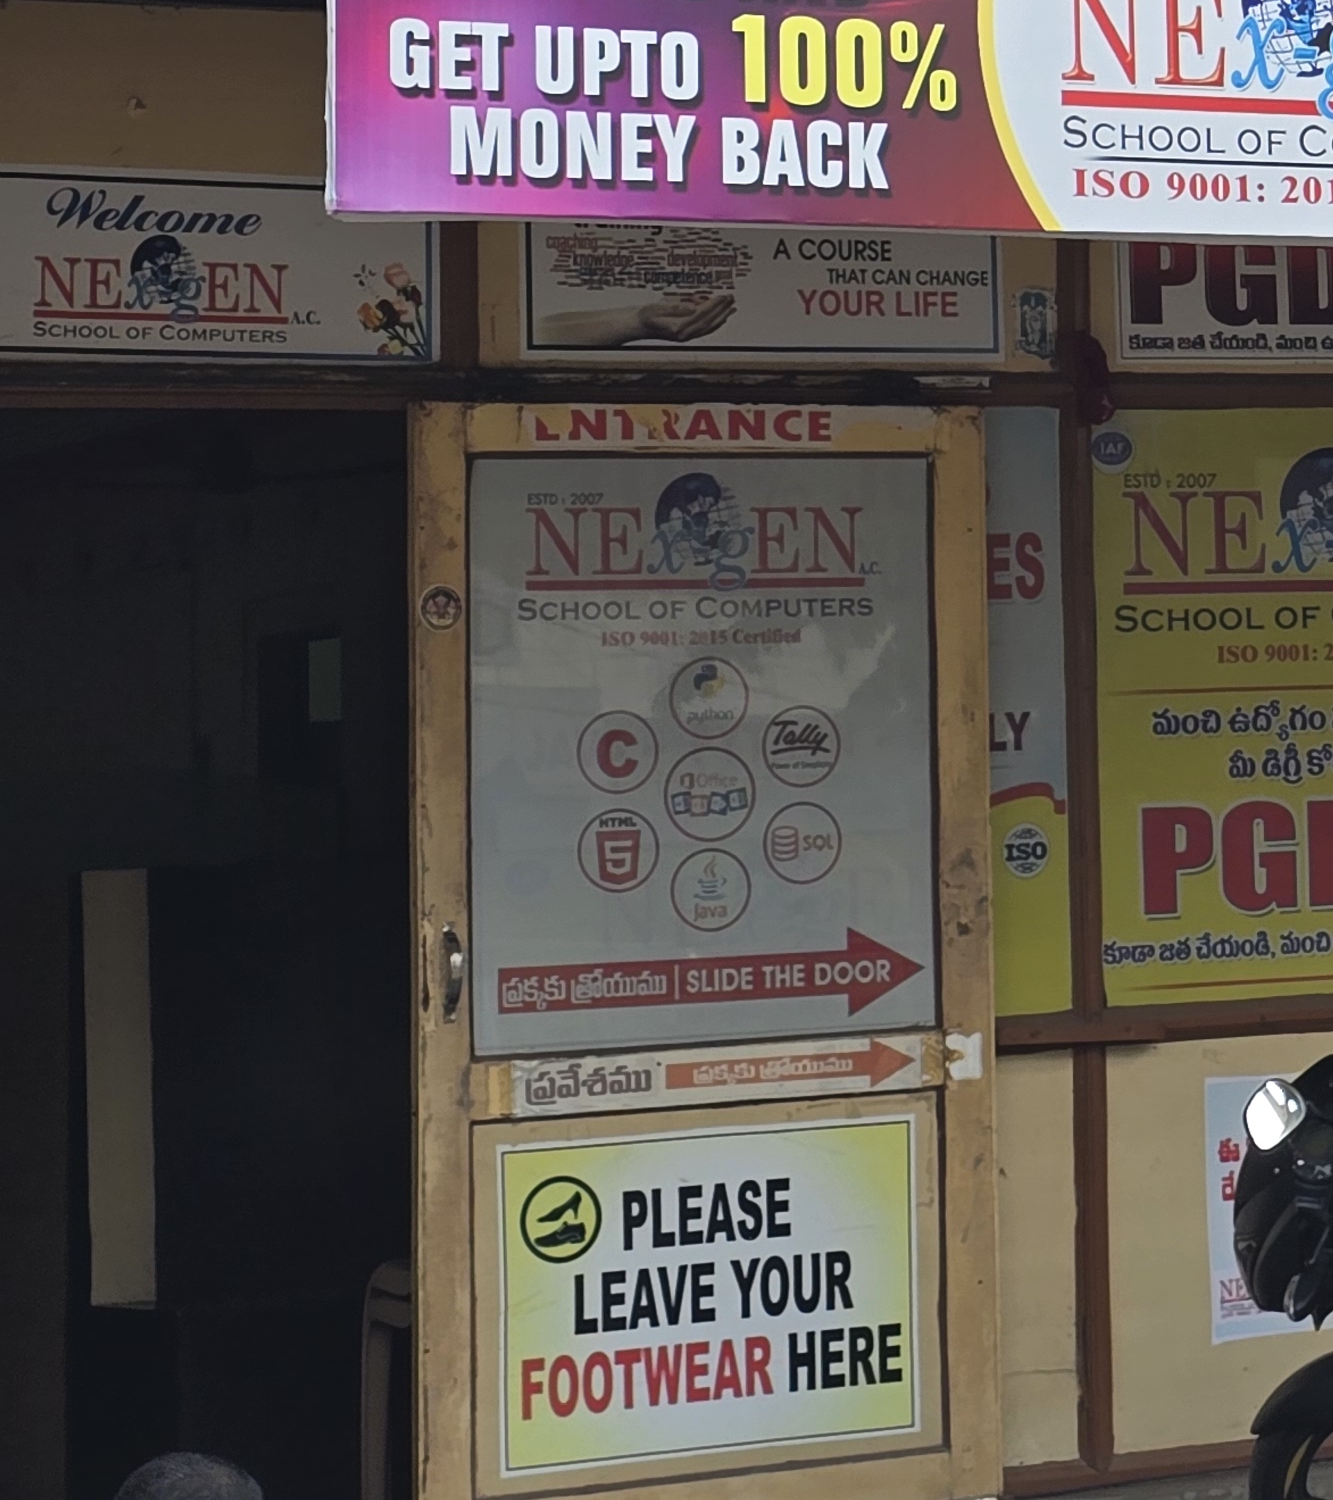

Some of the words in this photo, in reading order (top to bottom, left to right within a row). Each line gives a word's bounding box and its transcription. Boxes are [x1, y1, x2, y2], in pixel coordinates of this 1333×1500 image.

[389, 18, 510, 92] GET
[535, 25, 700, 100] UPTO
[732, 14, 957, 112] 100%
[450, 106, 696, 184] MONEY
[722, 117, 889, 190] BACK
[46, 186, 262, 236] Welcome
[773, 239, 792, 260] A
[799, 240, 891, 262] COURSE
[799, 289, 884, 317] YOUR
[896, 291, 959, 318] LIFE
[827, 269, 867, 286] THAT
[872, 269, 911, 286] CAN
[916, 269, 989, 288] CHANGE
[1152, 708, 1221, 737] మంచి
[1227, 700, 1326, 742] ఉద్యోగం
[686, 968, 753, 994] SLIDE
[762, 964, 805, 988] THE
[815, 959, 891, 986] DOOR
[623, 1177, 791, 1251] PLEASE
[573, 1262, 716, 1335] LEAVE
[731, 1250, 854, 1318] YOUR
[522, 1336, 774, 1421] FOOTWEAR
[789, 1323, 903, 1393] HERE
